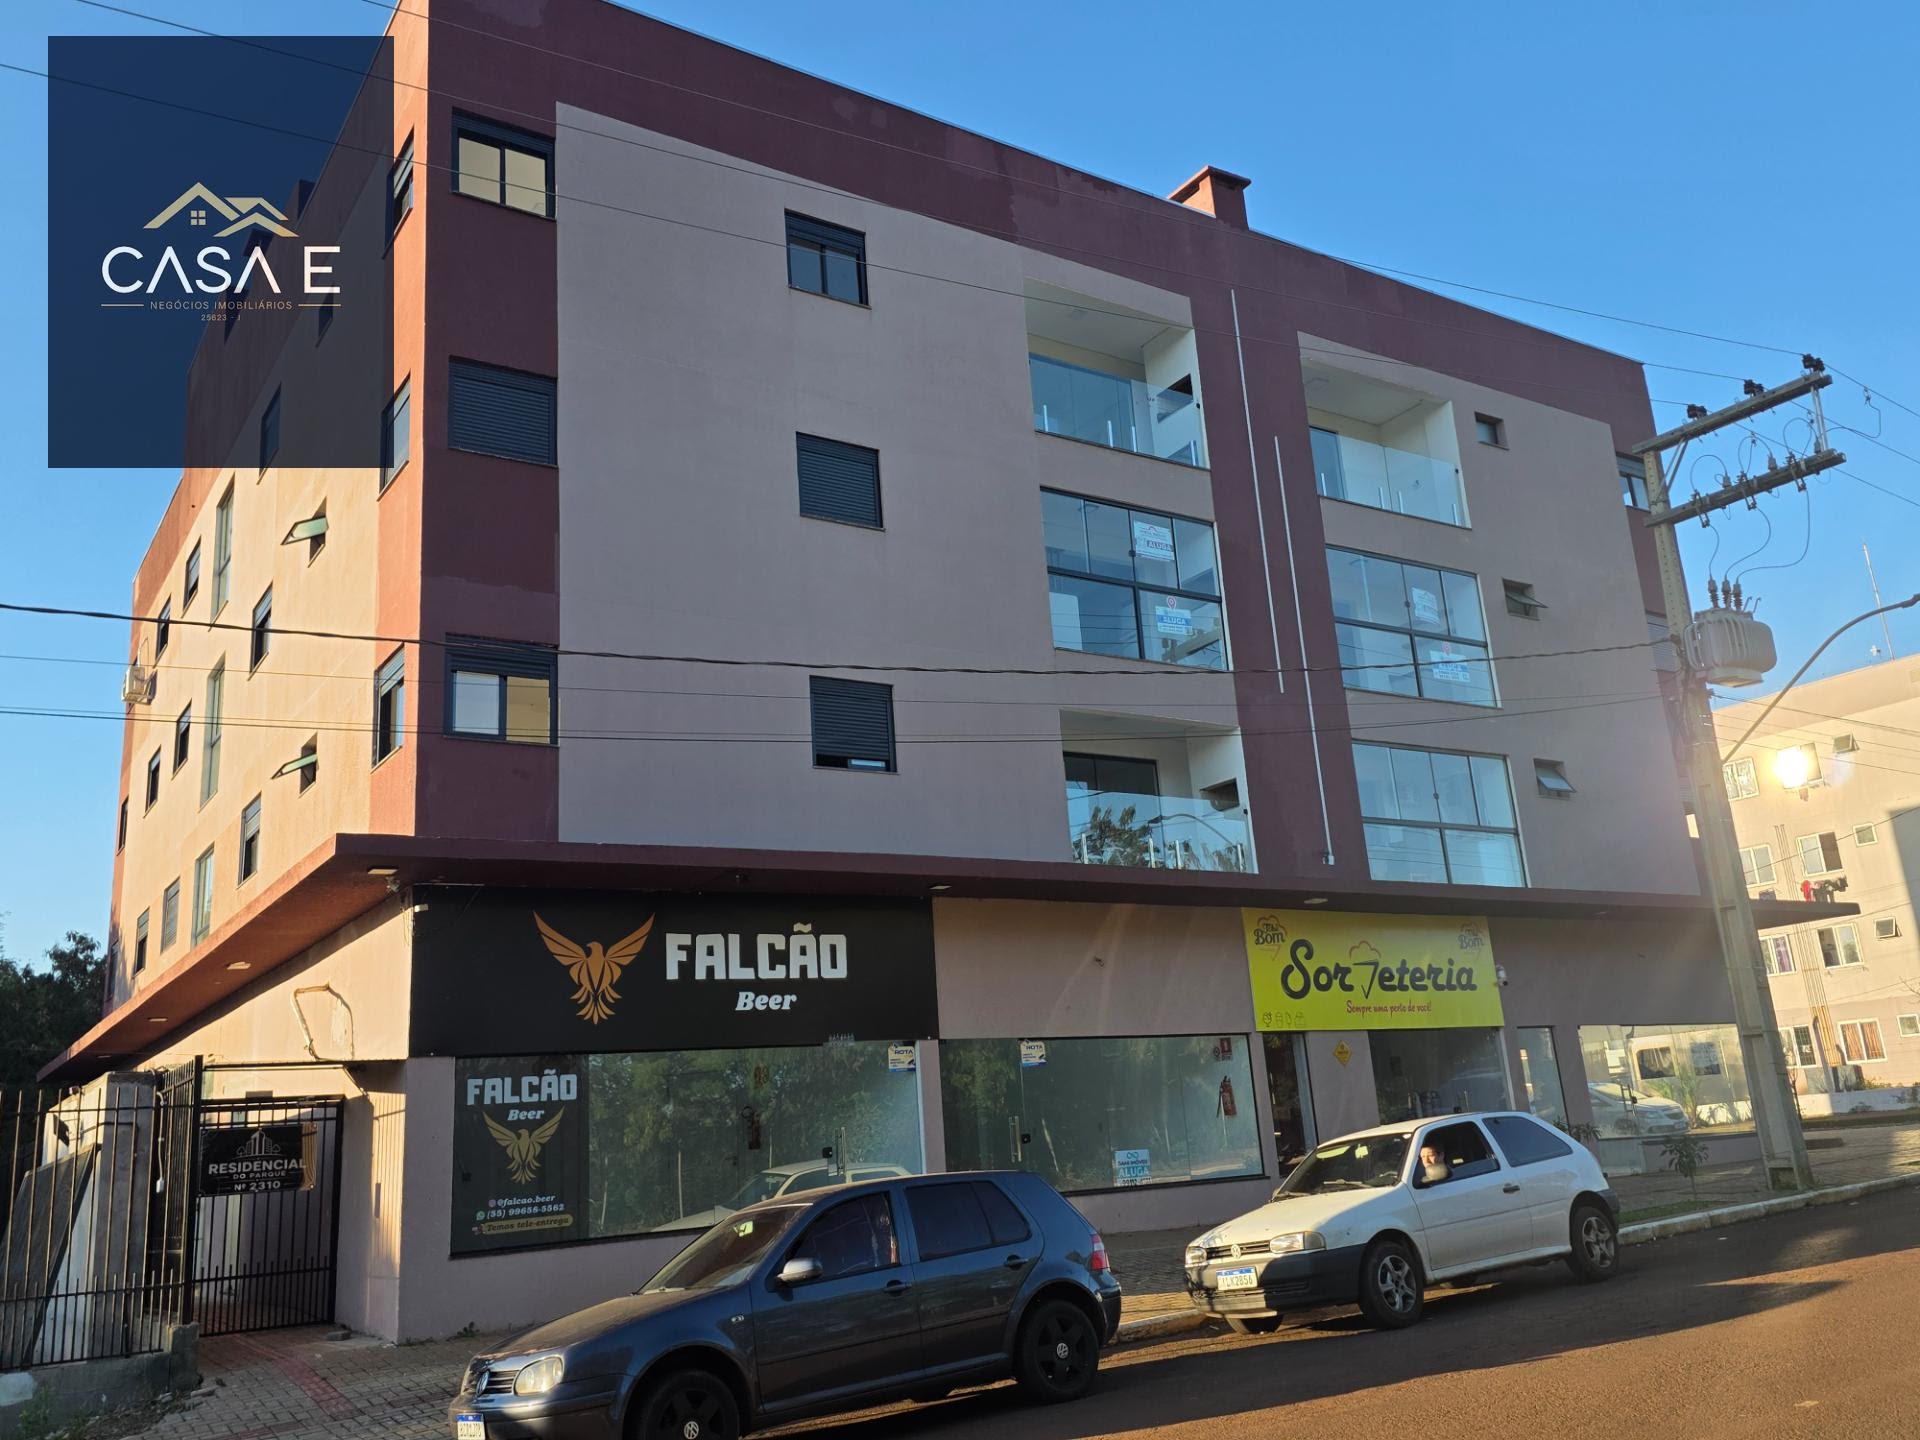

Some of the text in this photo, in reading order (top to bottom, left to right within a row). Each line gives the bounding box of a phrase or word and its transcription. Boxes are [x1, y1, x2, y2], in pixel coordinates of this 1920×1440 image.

[1253, 928, 1286, 945] Bom
[665, 922, 848, 981] FALCÃO
[735, 991, 797, 1012] Beer
[1346, 999, 1371, 1019] Sempre
[1407, 998, 1415, 1012] de
[466, 1069, 578, 1106] FALCÃO
[507, 1108, 545, 1121] Beer
[208, 1158, 307, 1175] RESIDENCIAL
[249, 1170, 286, 1178] PARQUE
[1118, 1165, 1150, 1178] ALUGA
[249, 1180, 281, 1191] 2310
[496, 1195, 556, 1208] @falcao.beer
[487, 1221, 514, 1232] Temos
